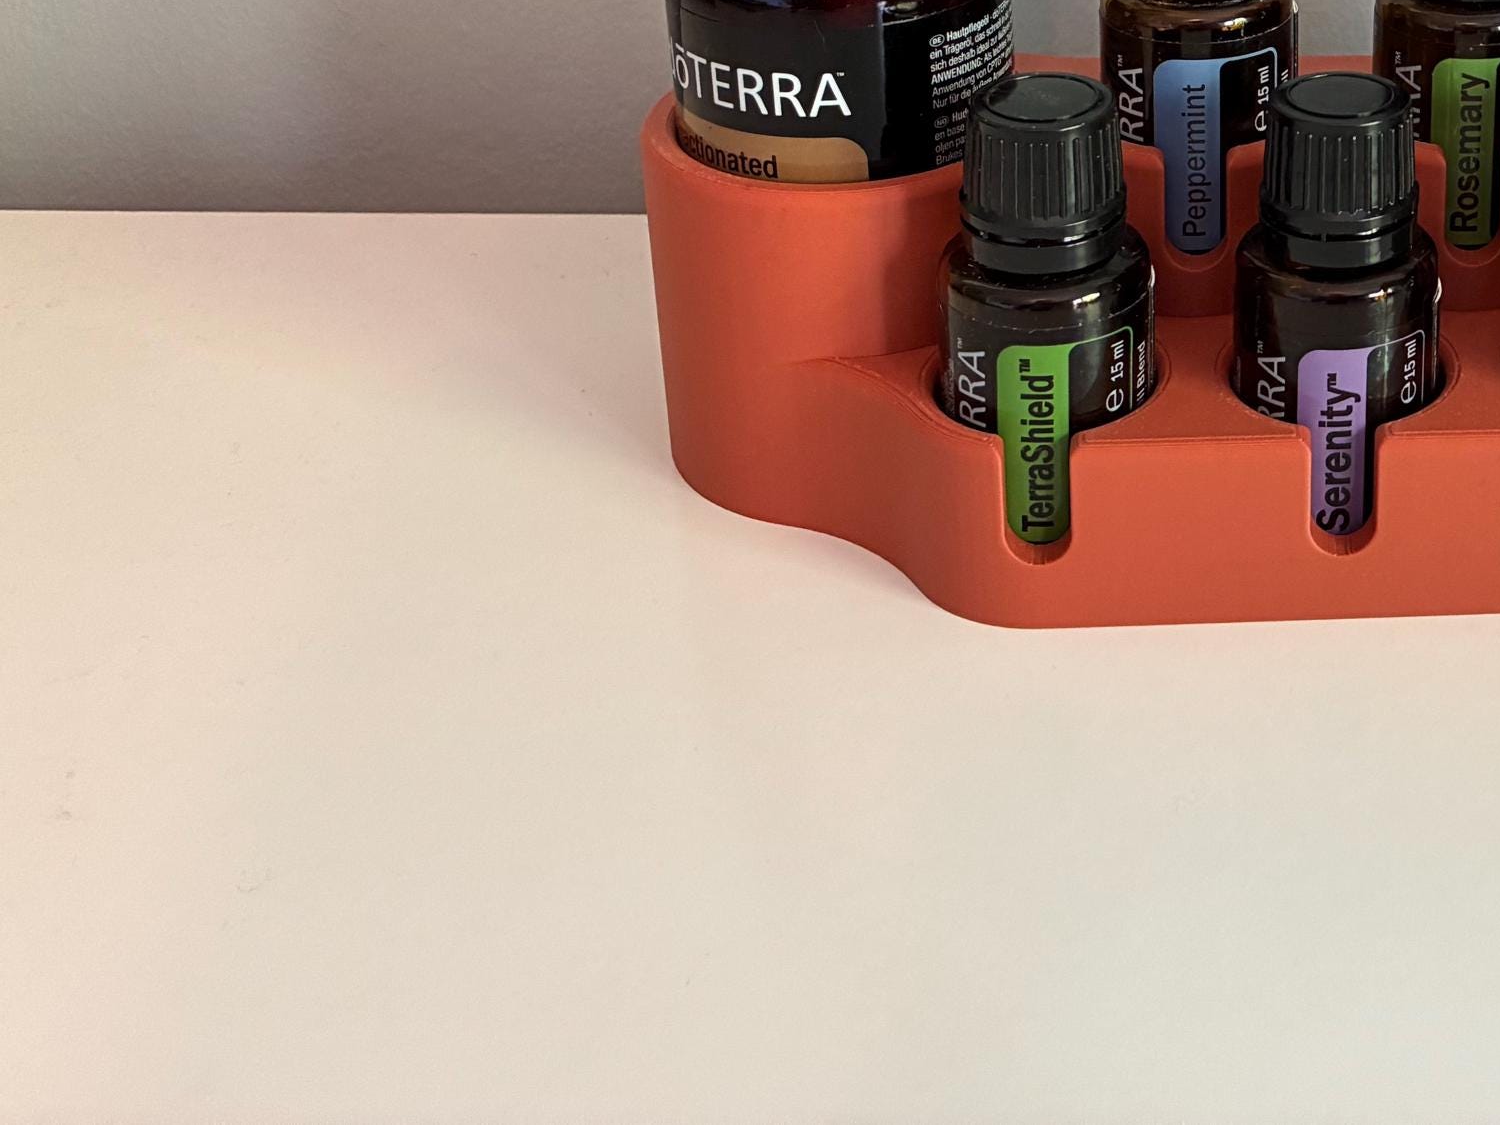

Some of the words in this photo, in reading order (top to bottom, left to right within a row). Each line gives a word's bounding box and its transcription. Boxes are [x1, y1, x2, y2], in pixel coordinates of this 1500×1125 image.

[930, 48, 943, 60] ein
[930, 59, 948, 73] sich
[1257, 65, 1270, 84] ml
[1256, 86, 1270, 105] 15
[1182, 83, 1212, 238] Peppermint
[1450, 72, 1490, 233] Rosemary
[1110, 339, 1125, 360] ml
[1404, 339, 1417, 359] ml
[1110, 361, 1124, 382] 15
[1136, 340, 1146, 389] Blend
[1404, 359, 1416, 381] 15
